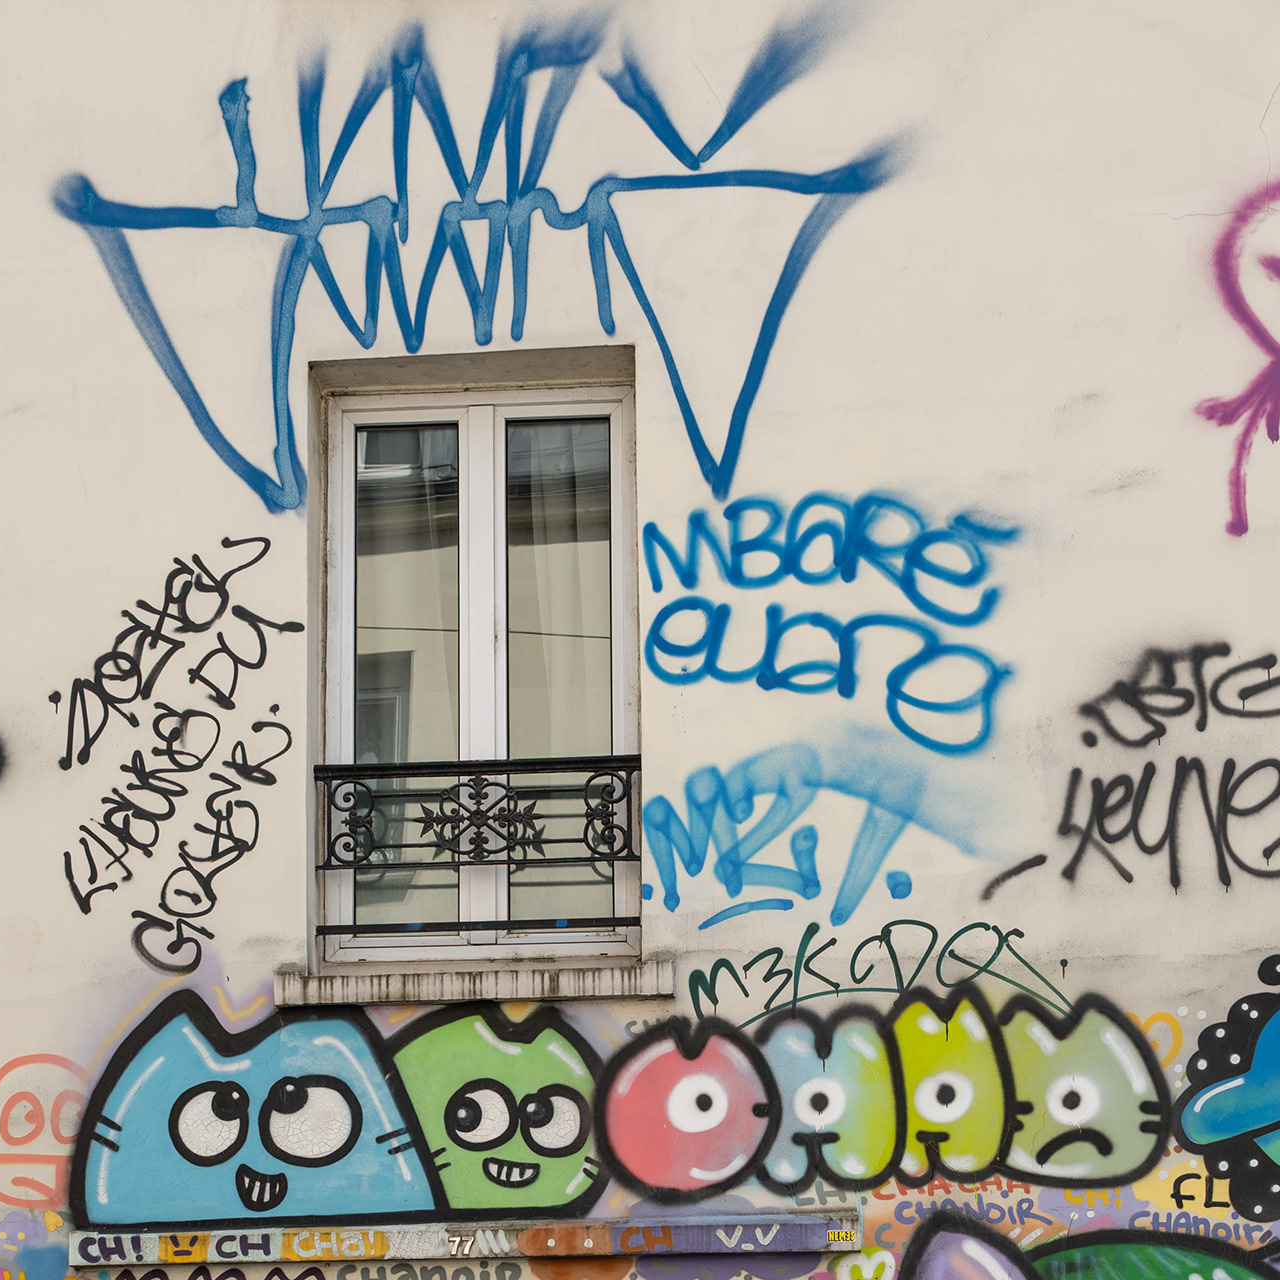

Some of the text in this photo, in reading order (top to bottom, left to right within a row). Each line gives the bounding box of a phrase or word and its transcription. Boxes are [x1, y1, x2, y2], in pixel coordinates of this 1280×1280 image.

[215, 1234, 270, 1259] CH
[449, 1236, 475, 1256] 77
[620, 1226, 673, 1252] CH
